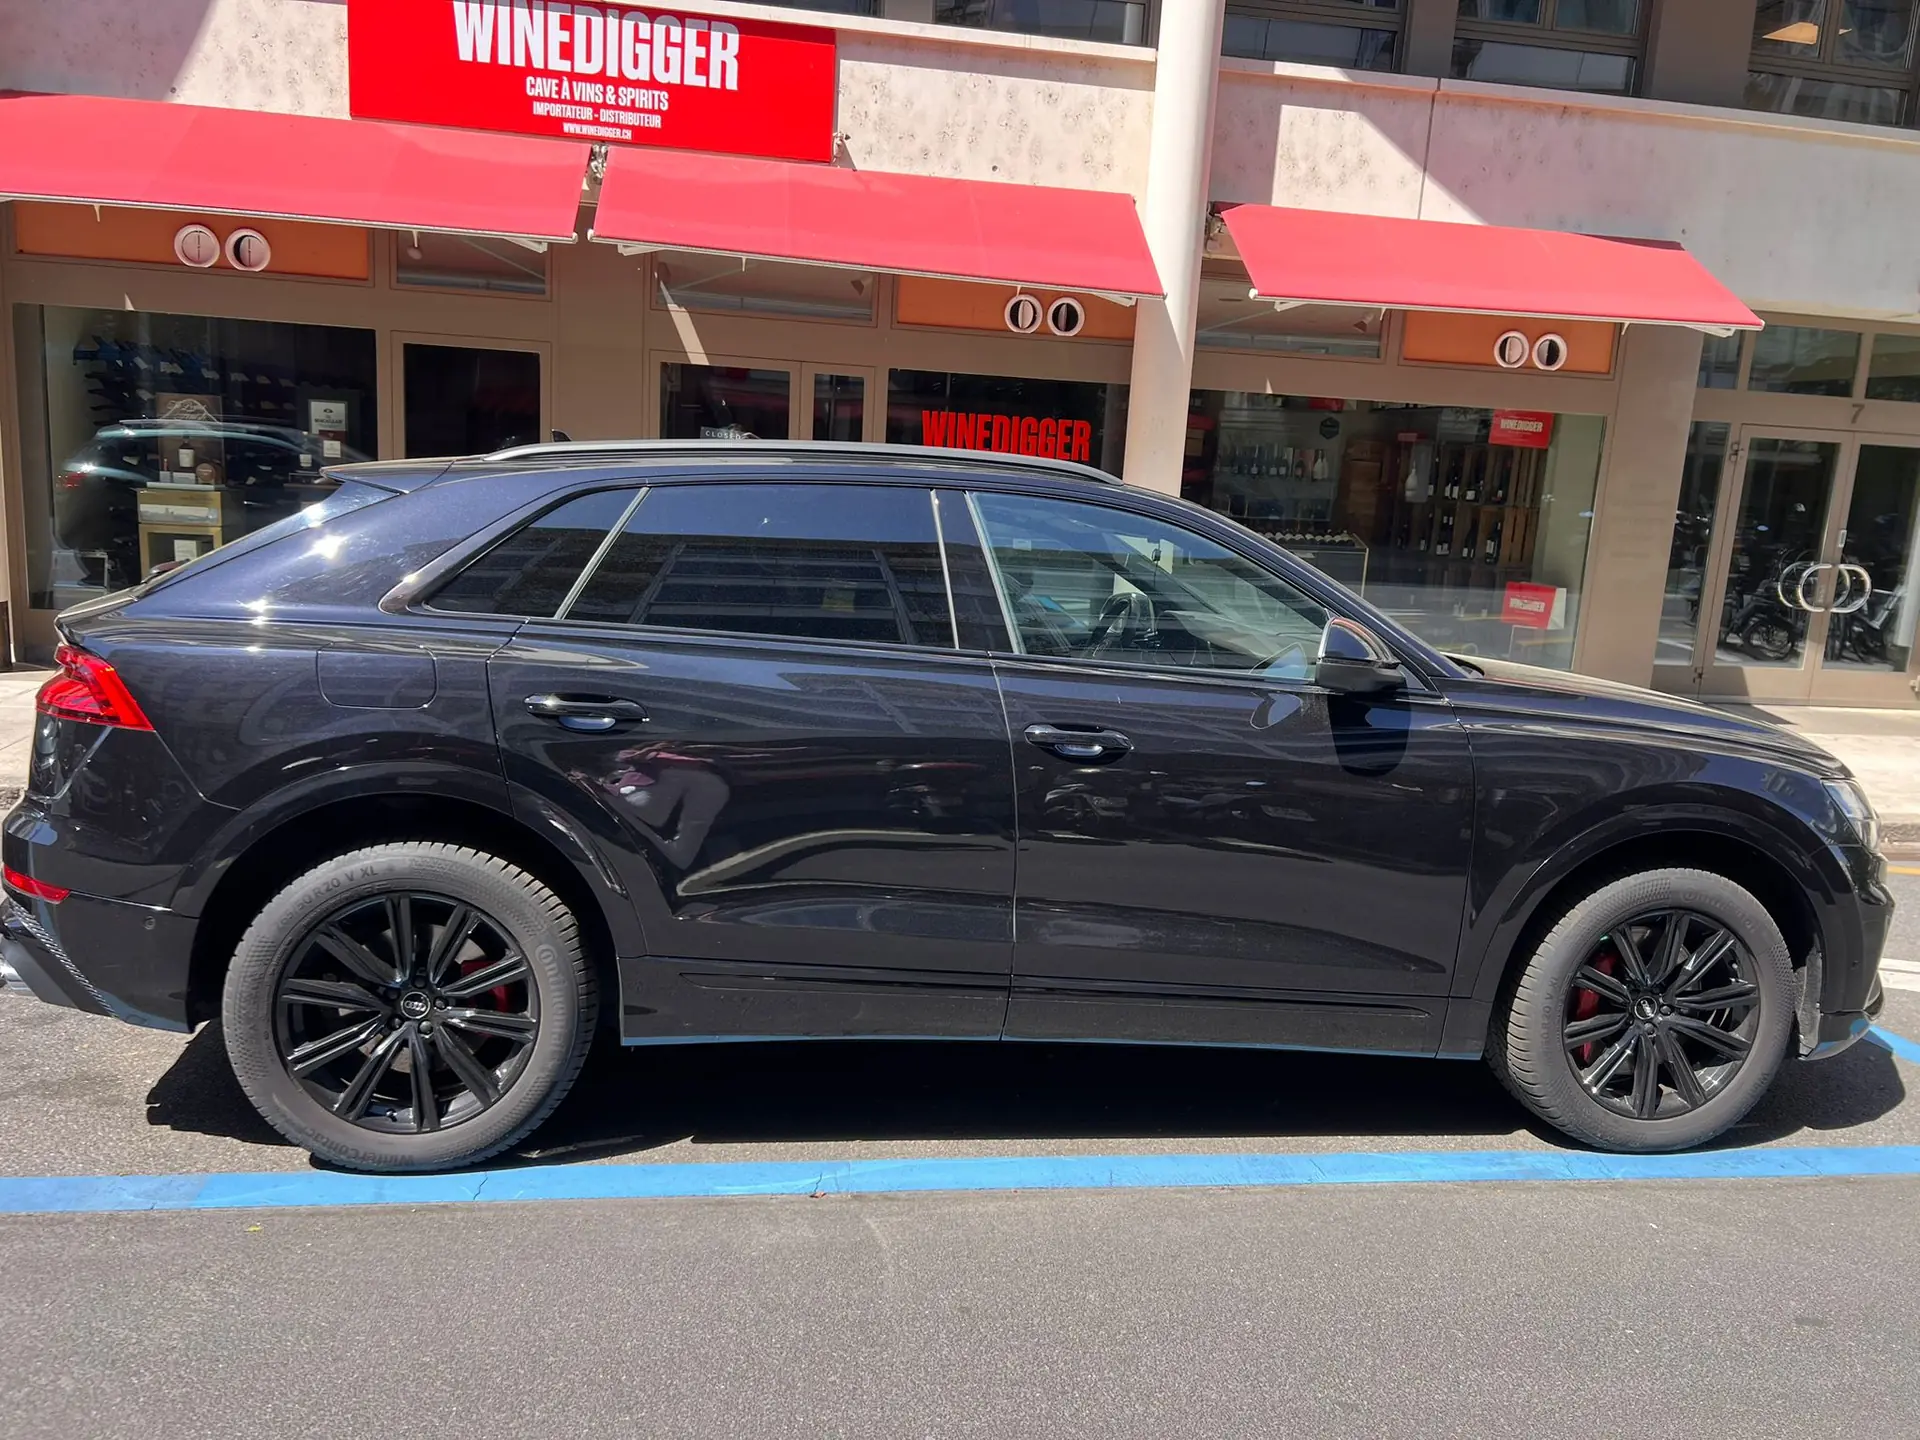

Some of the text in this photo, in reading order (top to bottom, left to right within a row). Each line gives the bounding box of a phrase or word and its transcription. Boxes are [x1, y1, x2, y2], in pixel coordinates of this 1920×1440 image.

[452, 0, 740, 91] WINEDIGGER
[526, 76, 669, 111] CAVE À VINS & SPIRITS
[533, 101, 593, 120] IMPORTATEUR
[600, 109, 662, 128] DISTRIBUTEUR
[1851, 404, 1865, 424] 7
[705, 430, 741, 440] CLOSED
[922, 410, 1091, 462] WINEDIGGER
[360, 865, 378, 878] XL
